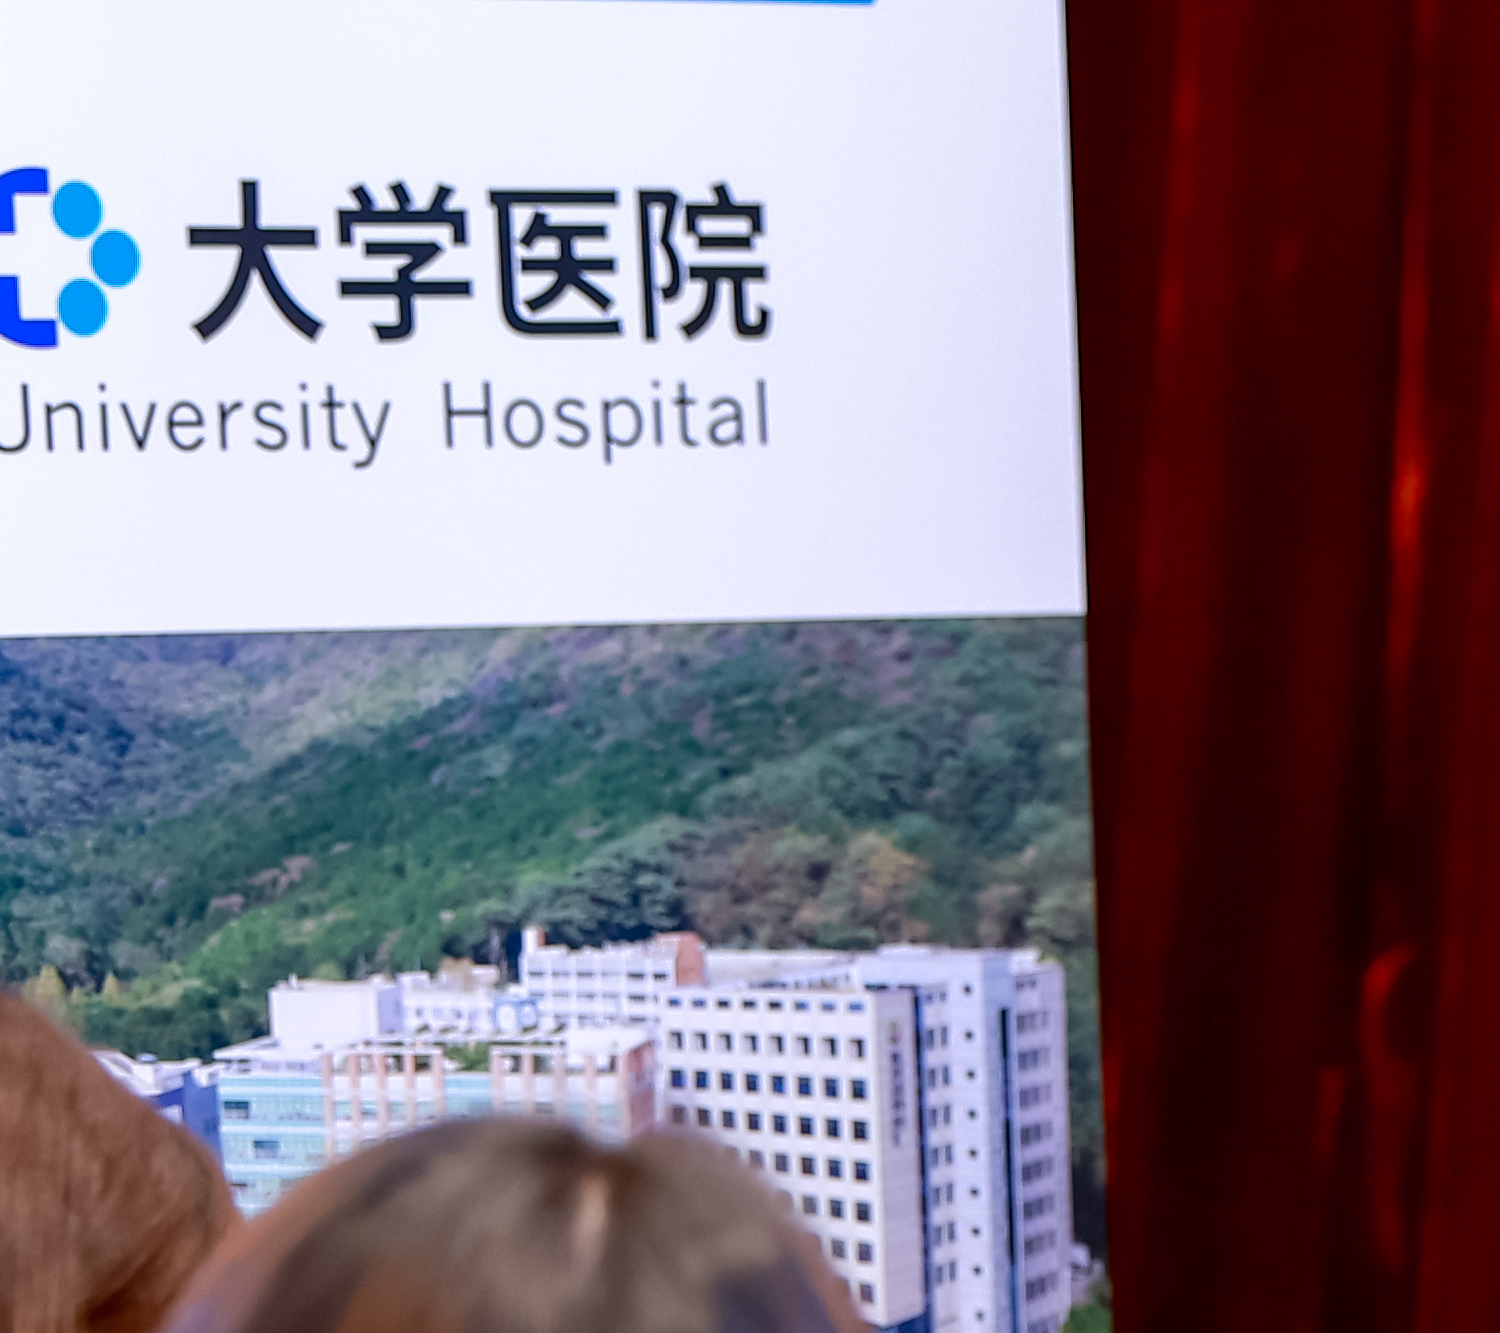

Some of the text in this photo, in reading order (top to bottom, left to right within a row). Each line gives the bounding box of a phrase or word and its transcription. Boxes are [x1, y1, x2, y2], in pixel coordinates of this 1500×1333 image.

[187, 180, 771, 343] 大学医院
[444, 380, 767, 463] Hospital
